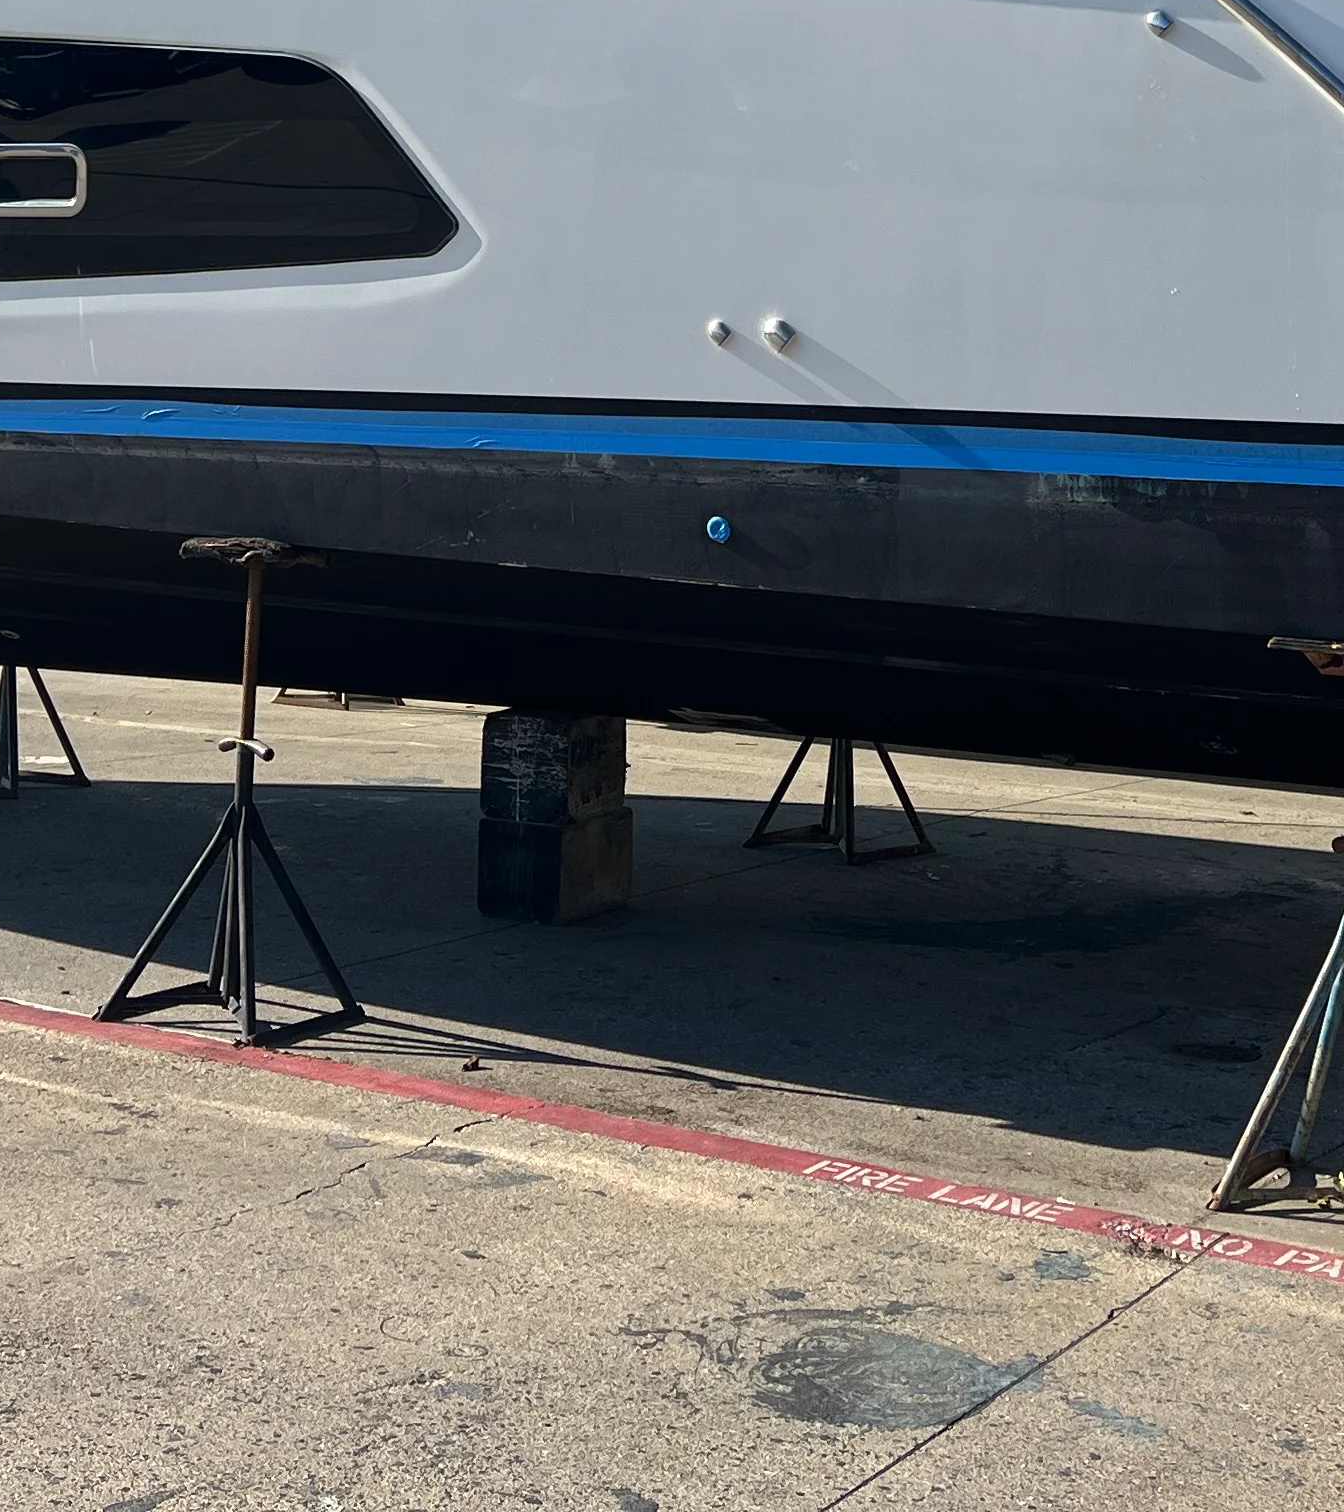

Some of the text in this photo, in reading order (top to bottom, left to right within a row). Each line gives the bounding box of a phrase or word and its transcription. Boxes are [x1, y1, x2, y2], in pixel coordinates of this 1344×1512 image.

[802, 1159, 924, 1194] FIRE
[928, 1184, 1074, 1223] LANE
[1171, 1227, 1253, 1258] NO
